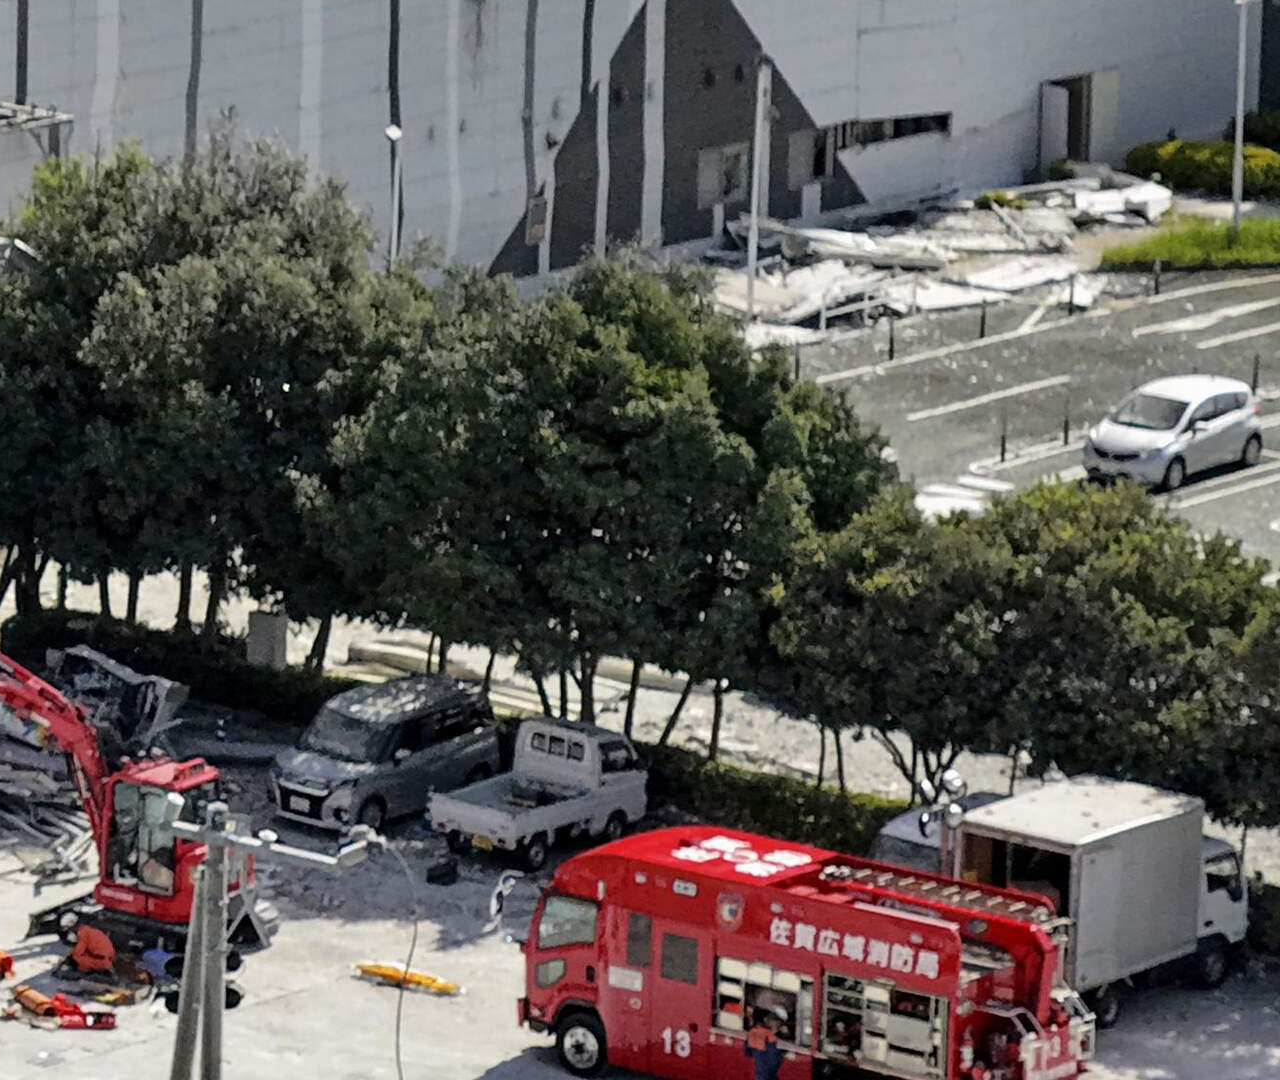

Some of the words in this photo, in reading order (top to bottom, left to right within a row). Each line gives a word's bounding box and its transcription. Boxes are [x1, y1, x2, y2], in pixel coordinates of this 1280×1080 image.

[769, 916, 940, 980] 佐賀広域消防局
[661, 1026, 691, 1058] 13
